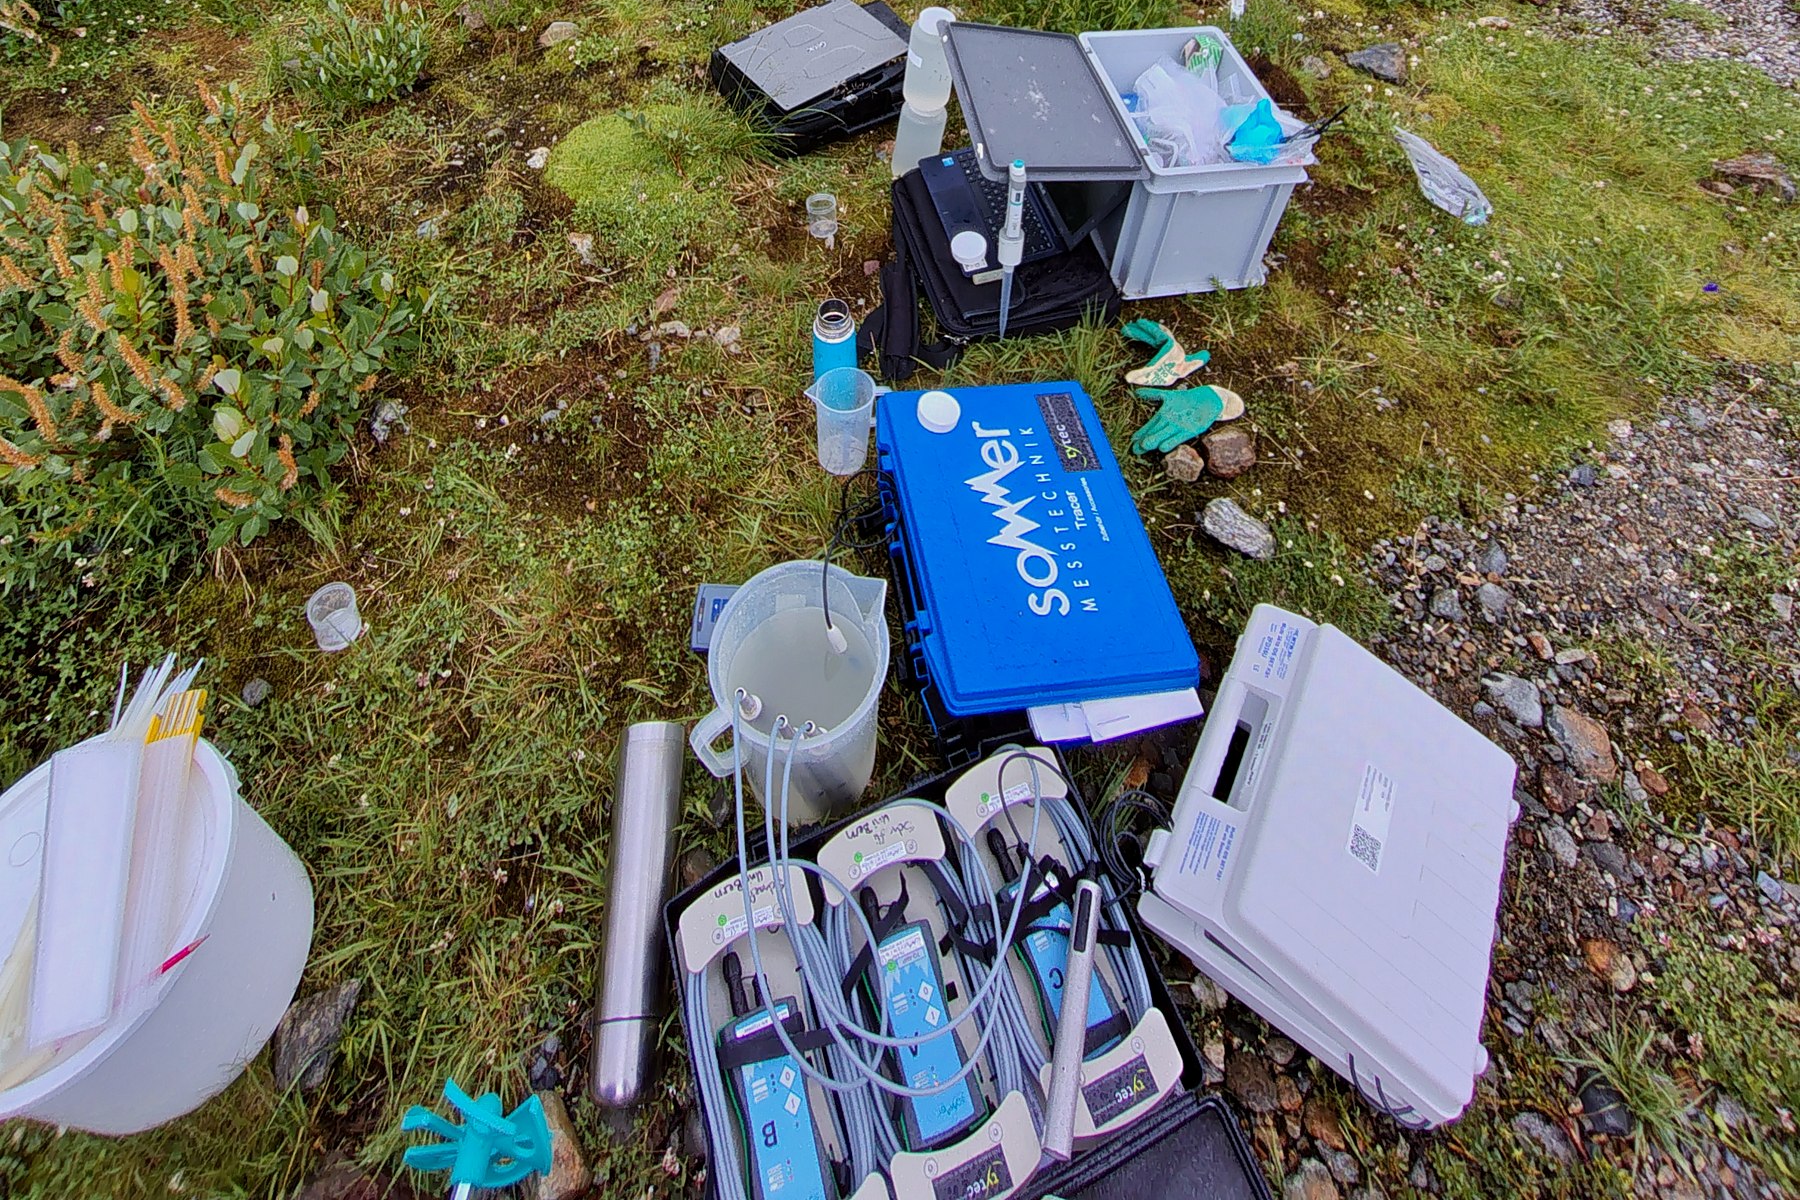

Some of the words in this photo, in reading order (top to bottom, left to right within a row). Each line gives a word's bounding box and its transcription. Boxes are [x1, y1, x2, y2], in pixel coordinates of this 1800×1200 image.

[1065, 490, 1088, 531] Tracer
[714, 879, 743, 898] Bern
[1049, 967, 1064, 989] C
[1115, 1074, 1147, 1104] tytec
[762, 1119, 778, 1147] B
[967, 1166, 1000, 1200] tytec
